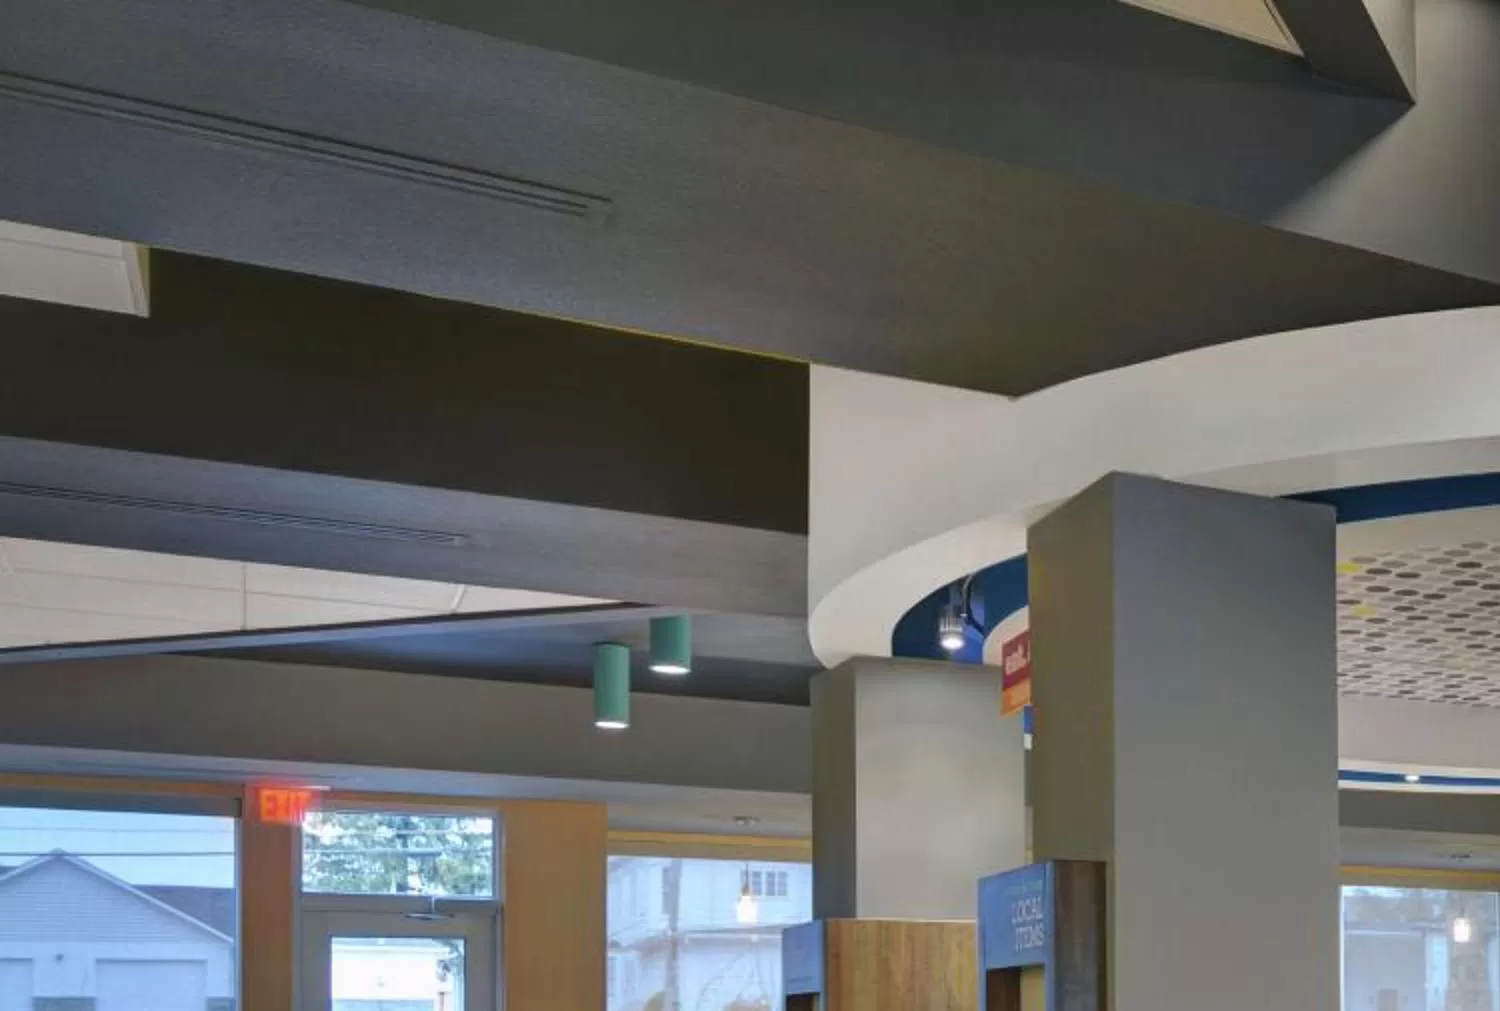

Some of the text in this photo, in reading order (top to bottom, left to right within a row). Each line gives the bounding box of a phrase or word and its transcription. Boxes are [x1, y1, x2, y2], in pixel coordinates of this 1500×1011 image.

[261, 789, 312, 823] EXIT
[1011, 895, 1043, 924] LOCAL
[1015, 923, 1044, 952] ITEMS
